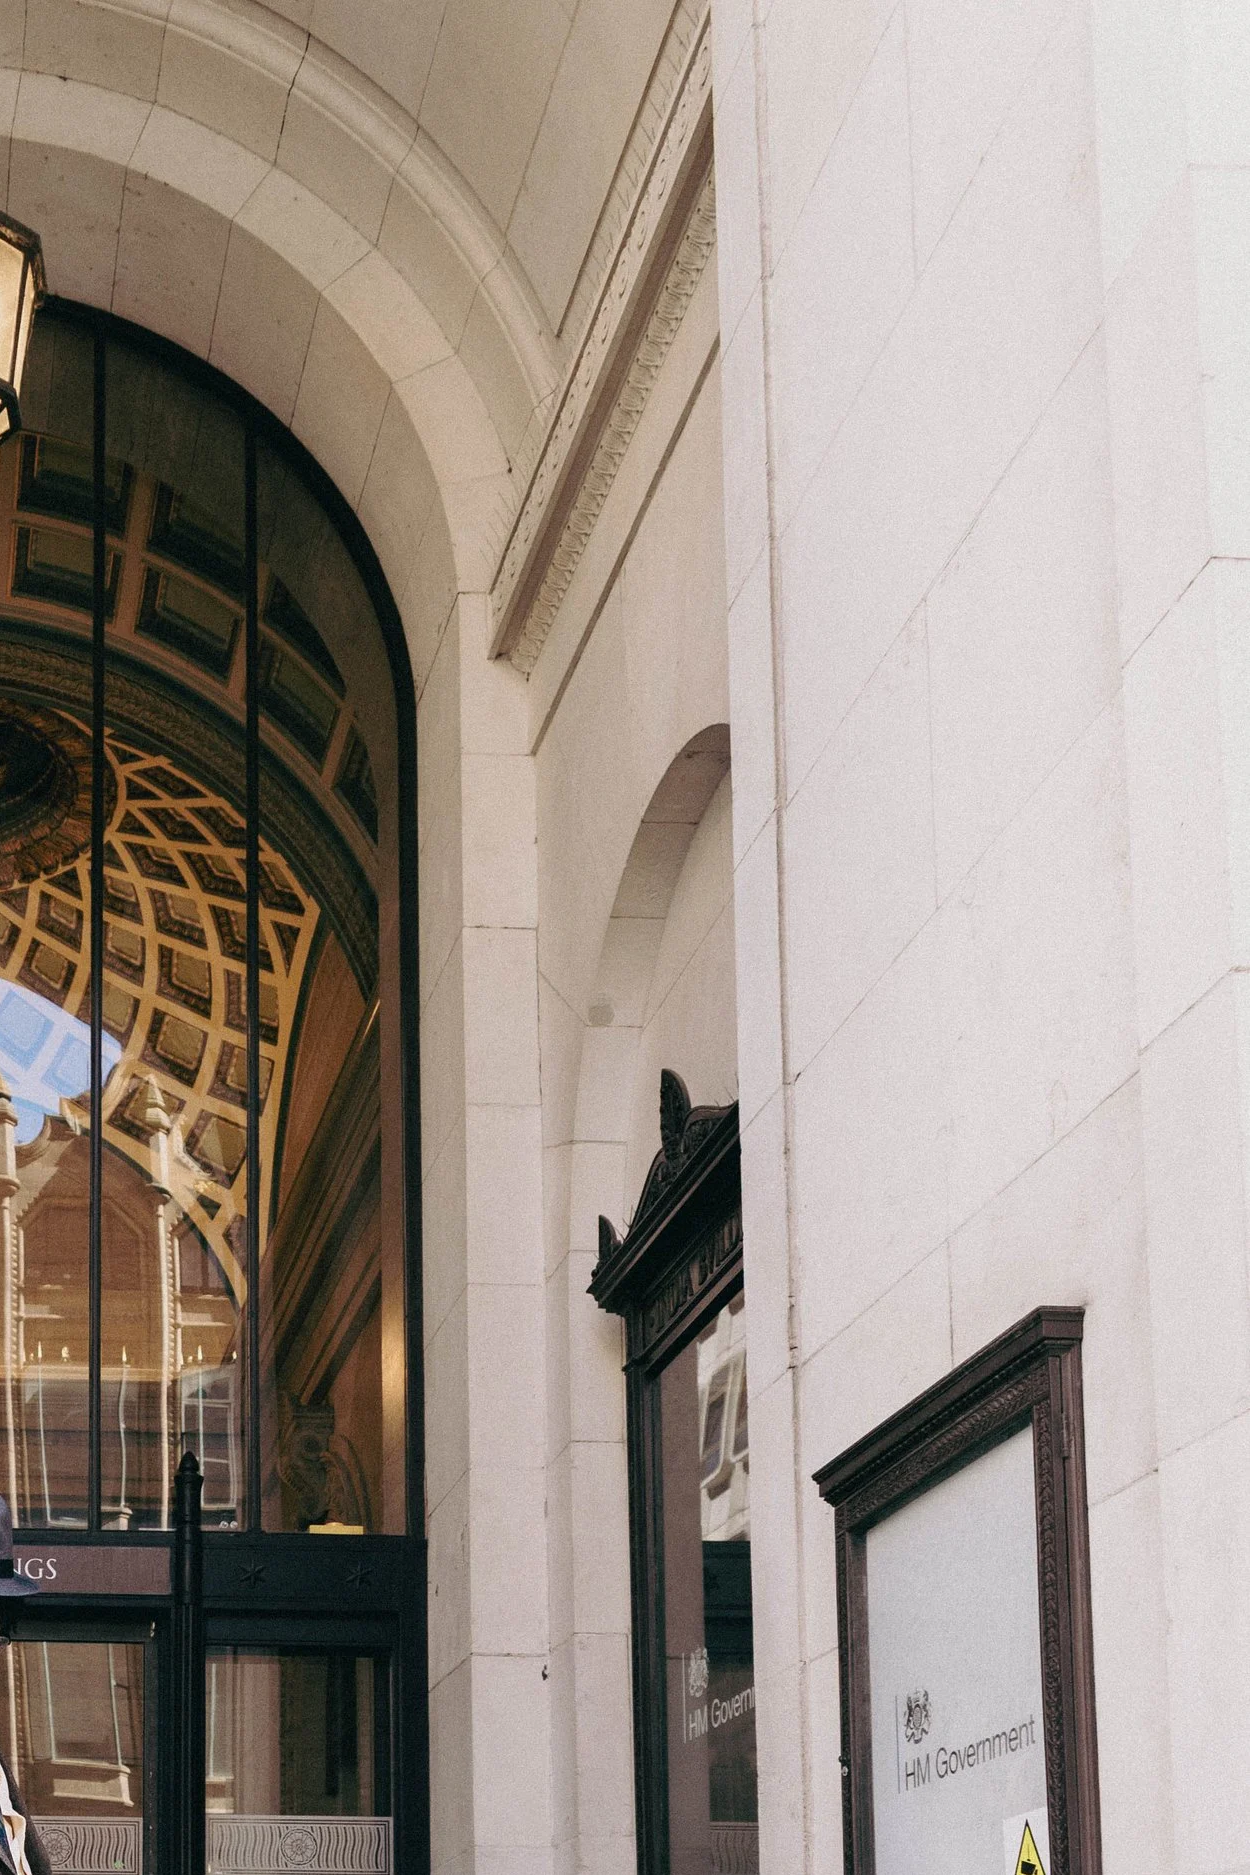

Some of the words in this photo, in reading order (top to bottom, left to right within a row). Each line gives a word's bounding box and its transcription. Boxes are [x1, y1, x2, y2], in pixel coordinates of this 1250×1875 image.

[689, 1704, 708, 1740] HM
[905, 1753, 931, 1791] HM
[935, 1714, 1036, 1779] Government
